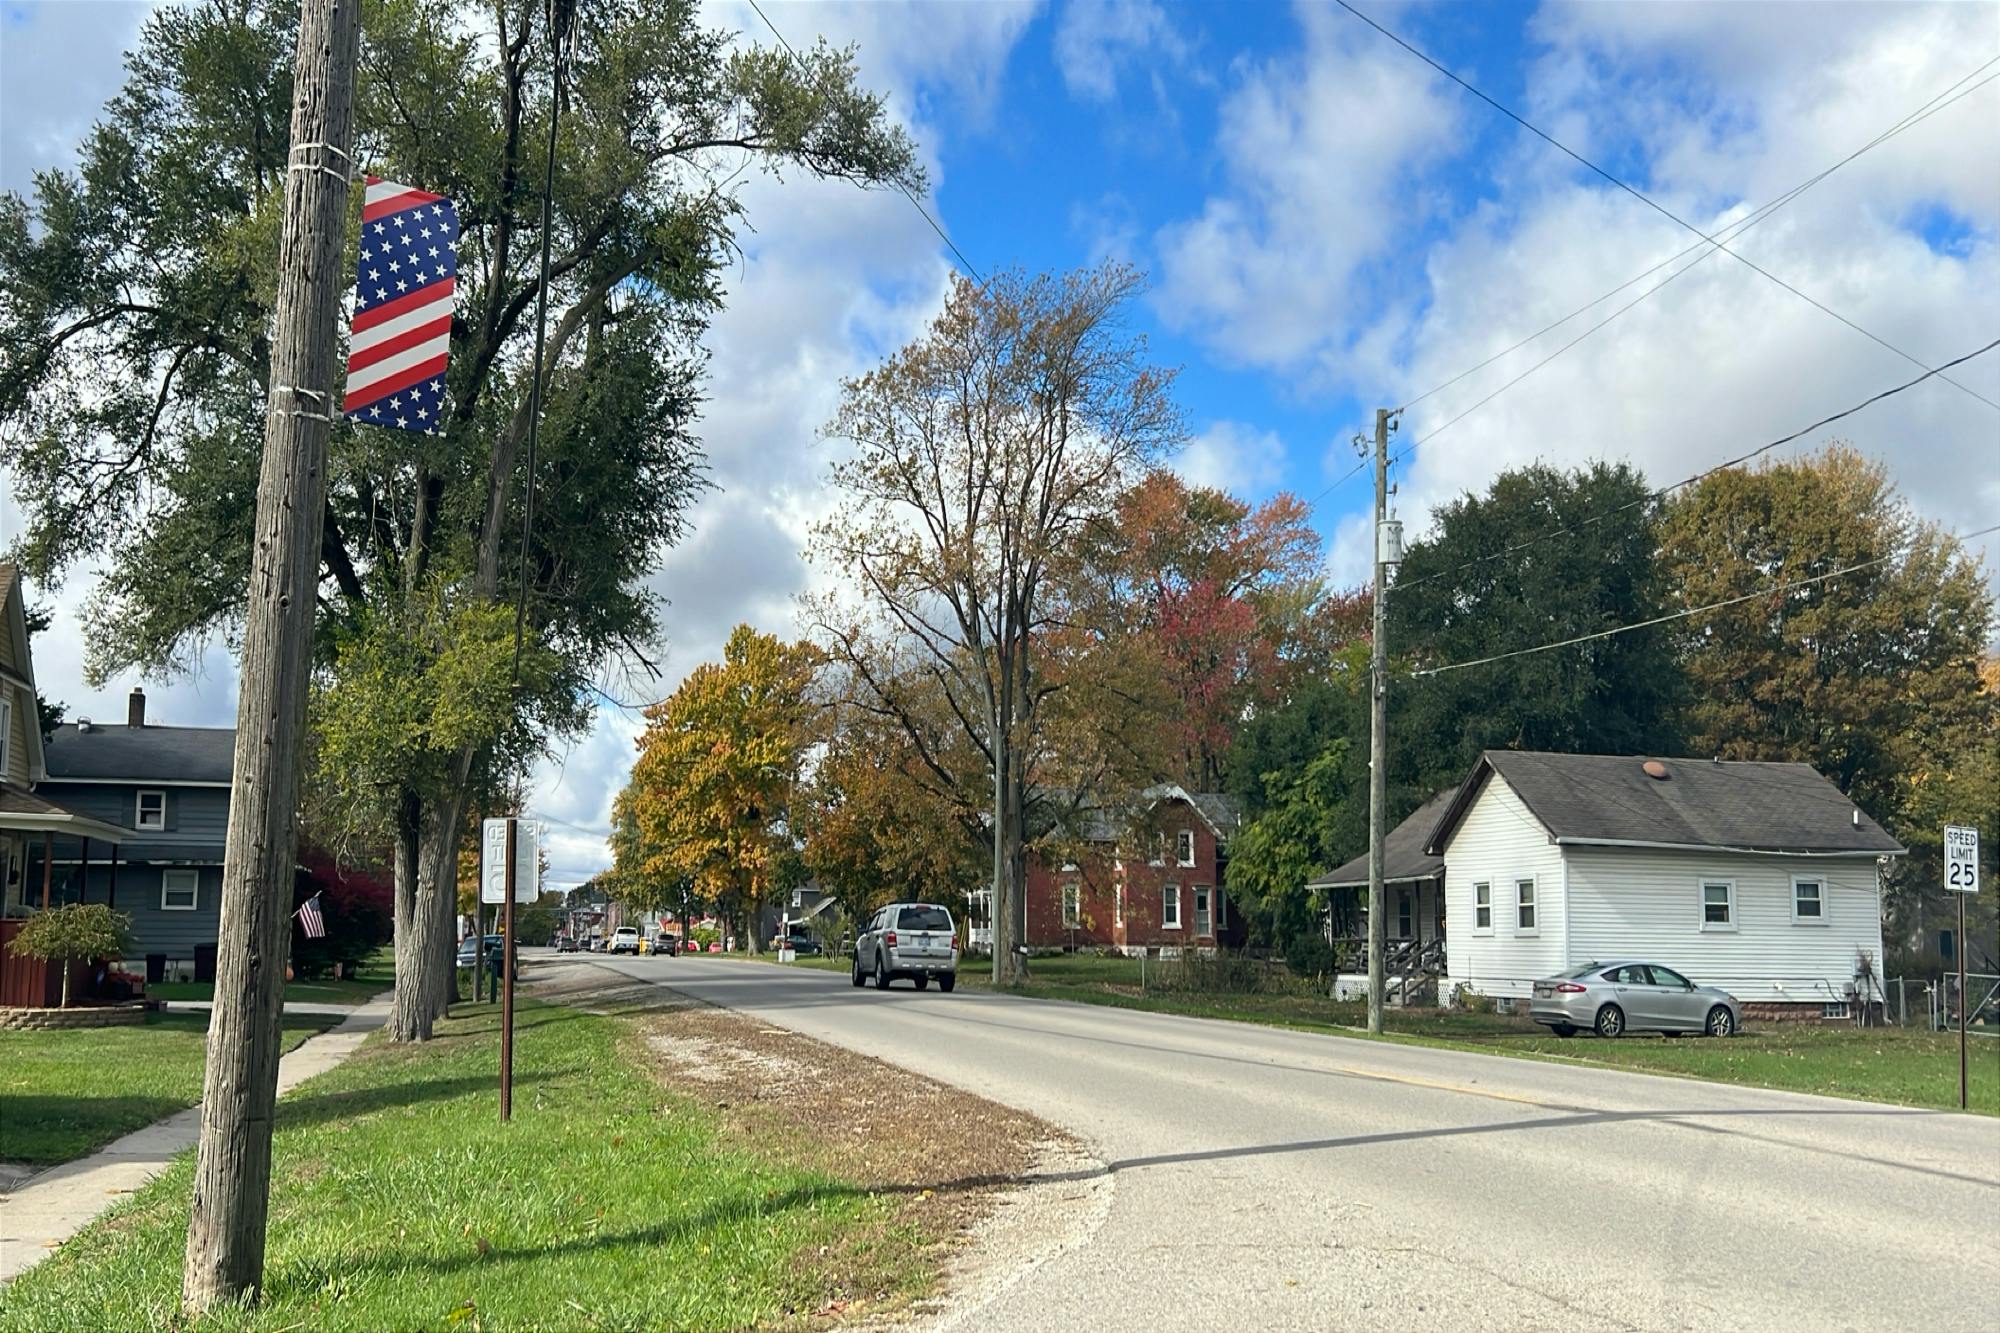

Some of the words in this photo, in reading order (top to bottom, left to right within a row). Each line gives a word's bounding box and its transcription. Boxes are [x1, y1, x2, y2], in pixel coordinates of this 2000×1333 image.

[1948, 831, 1975, 846] SPEED
[1951, 847, 1973, 860] LIMIT
[1950, 862, 1974, 886] 25
